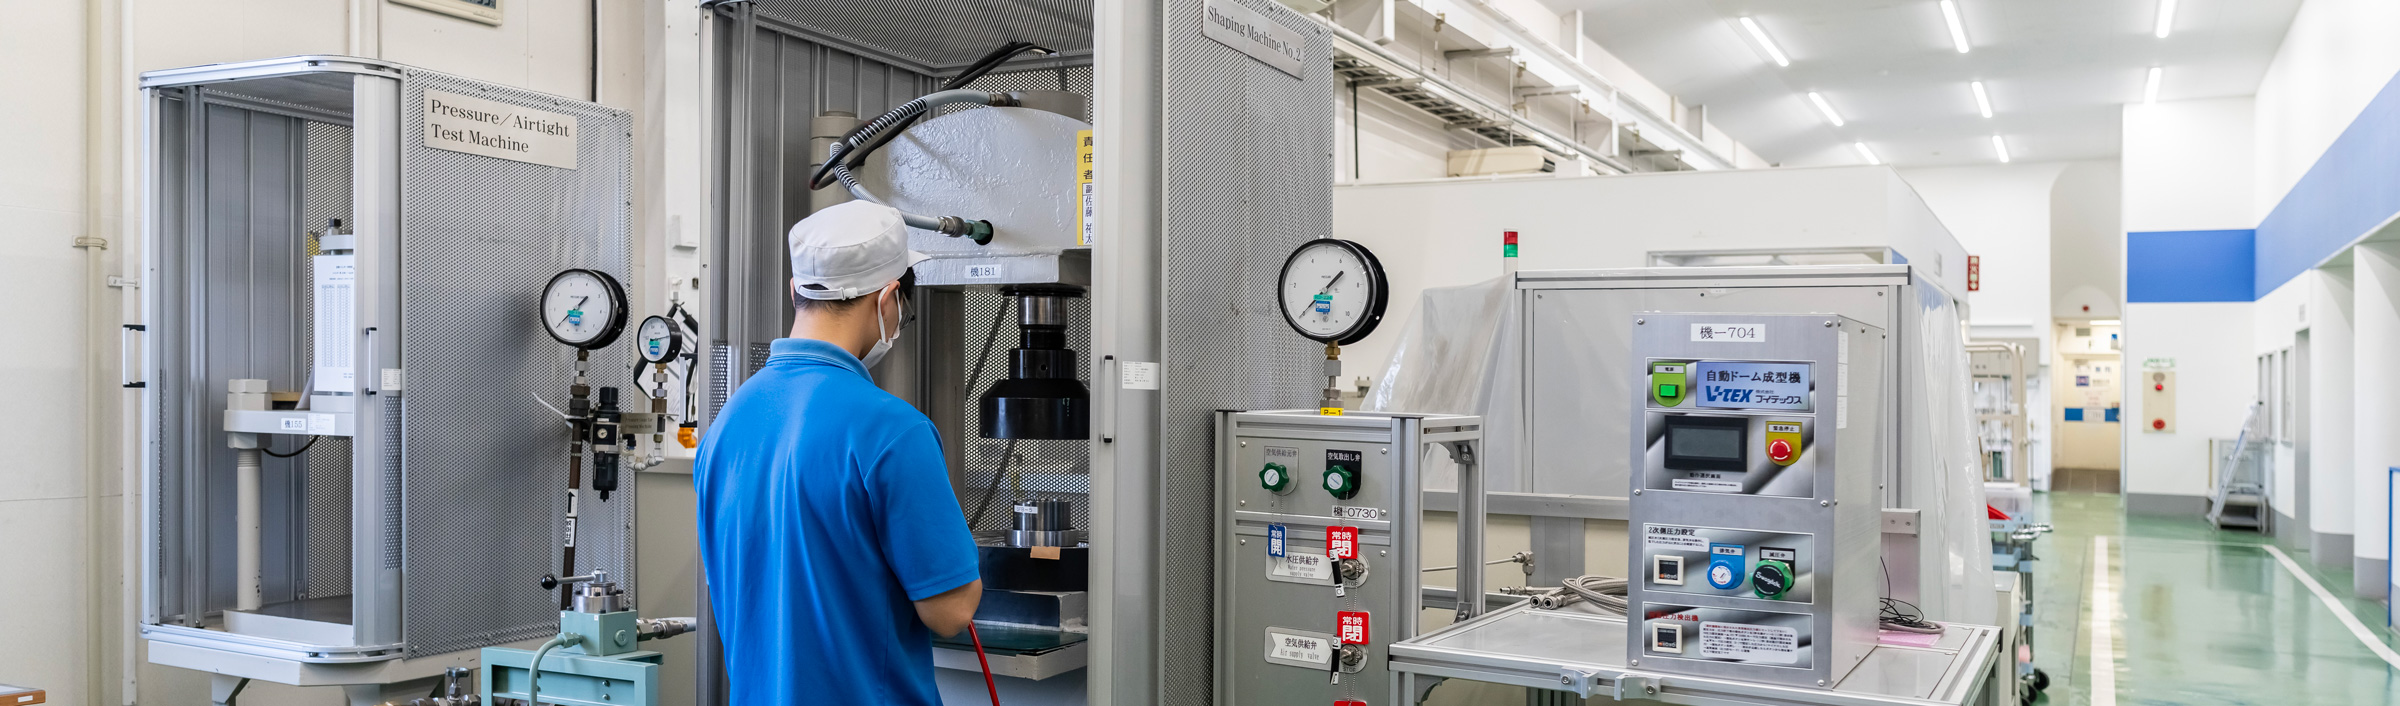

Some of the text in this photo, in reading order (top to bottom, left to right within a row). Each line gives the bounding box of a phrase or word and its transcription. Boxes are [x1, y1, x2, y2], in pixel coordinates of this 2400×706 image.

[1208, 5, 1301, 62] Shaping Machine No.2
[431, 123, 529, 153] Test Machine
[1706, 370, 1801, 384] 自動ドーム成型機
[1755, 394, 1802, 405] ブイテックス
[1327, 452, 1361, 462] 空気取出し弁
[1332, 531, 1352, 540] 常時
[1286, 555, 1319, 566] 水圧供給弁
[1343, 616, 1362, 625] 常時
[1343, 625, 1362, 642] 閉
[1285, 637, 1317, 650] 空気供給弁
